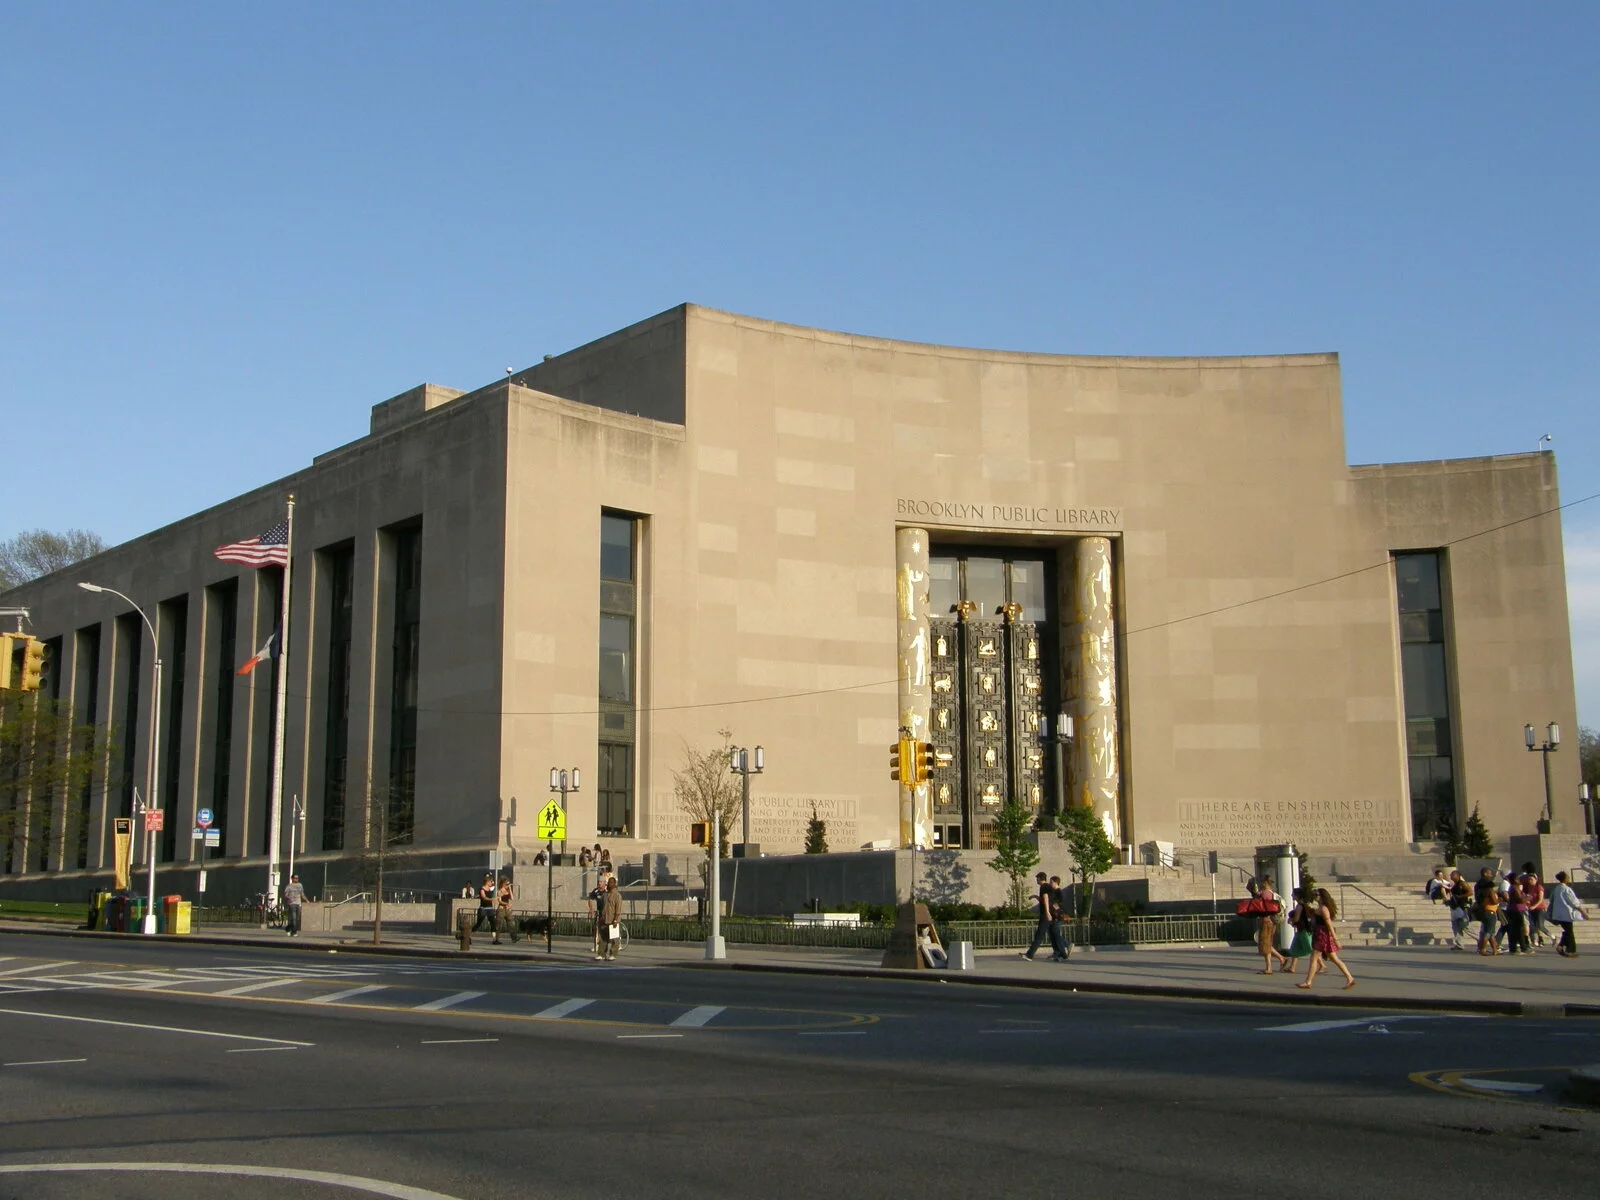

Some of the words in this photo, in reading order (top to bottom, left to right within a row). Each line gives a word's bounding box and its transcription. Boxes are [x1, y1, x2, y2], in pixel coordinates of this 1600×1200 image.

[896, 498, 984, 519] BROOKLYN
[992, 505, 1048, 523] PUBLIC
[1055, 508, 1121, 525] LIBRARY
[758, 796, 794, 808] PUBLIC
[797, 798, 837, 809] LIBRARY
[1201, 801, 1238, 812] HERE
[1243, 801, 1271, 812] ARE
[1277, 800, 1373, 812] ENSHRINED
[777, 809, 788, 817] OF
[1201, 813, 1221, 821] THE
[1225, 813, 1272, 821] LONGING
[1276, 812, 1289, 821] OF
[1294, 812, 1325, 821] GREAT
[1331, 811, 1373, 820] HEARTS
[752, 818, 800, 826] GENEROSITY
[833, 820, 842, 828] TO
[844, 820, 857, 828] ALL
[1229, 821, 1262, 829] THINGS
[1266, 821, 1285, 829] THAT
[1289, 821, 1319, 829] TOWER
[1358, 820, 1375, 828] THE
[655, 823, 671, 831] THE
[773, 827, 791, 835] FREE
[830, 828, 839, 836] TO
[842, 828, 857, 836] THE
[1260, 829, 1280, 837] THAT
[1284, 829, 1322, 837] WINGED
[1325, 828, 1365, 836] WONDER
[1368, 828, 1401, 836] STARTS
[750, 835, 788, 843] THOUGHT
[791, 836, 800, 844] OF
[1179, 838, 1196, 846] THE
[1200, 838, 1253, 846] GARNERED
[1298, 837, 1319, 845] THAT
[1321, 837, 1339, 845] HAS
[1378, 836, 1402, 844] DIED
